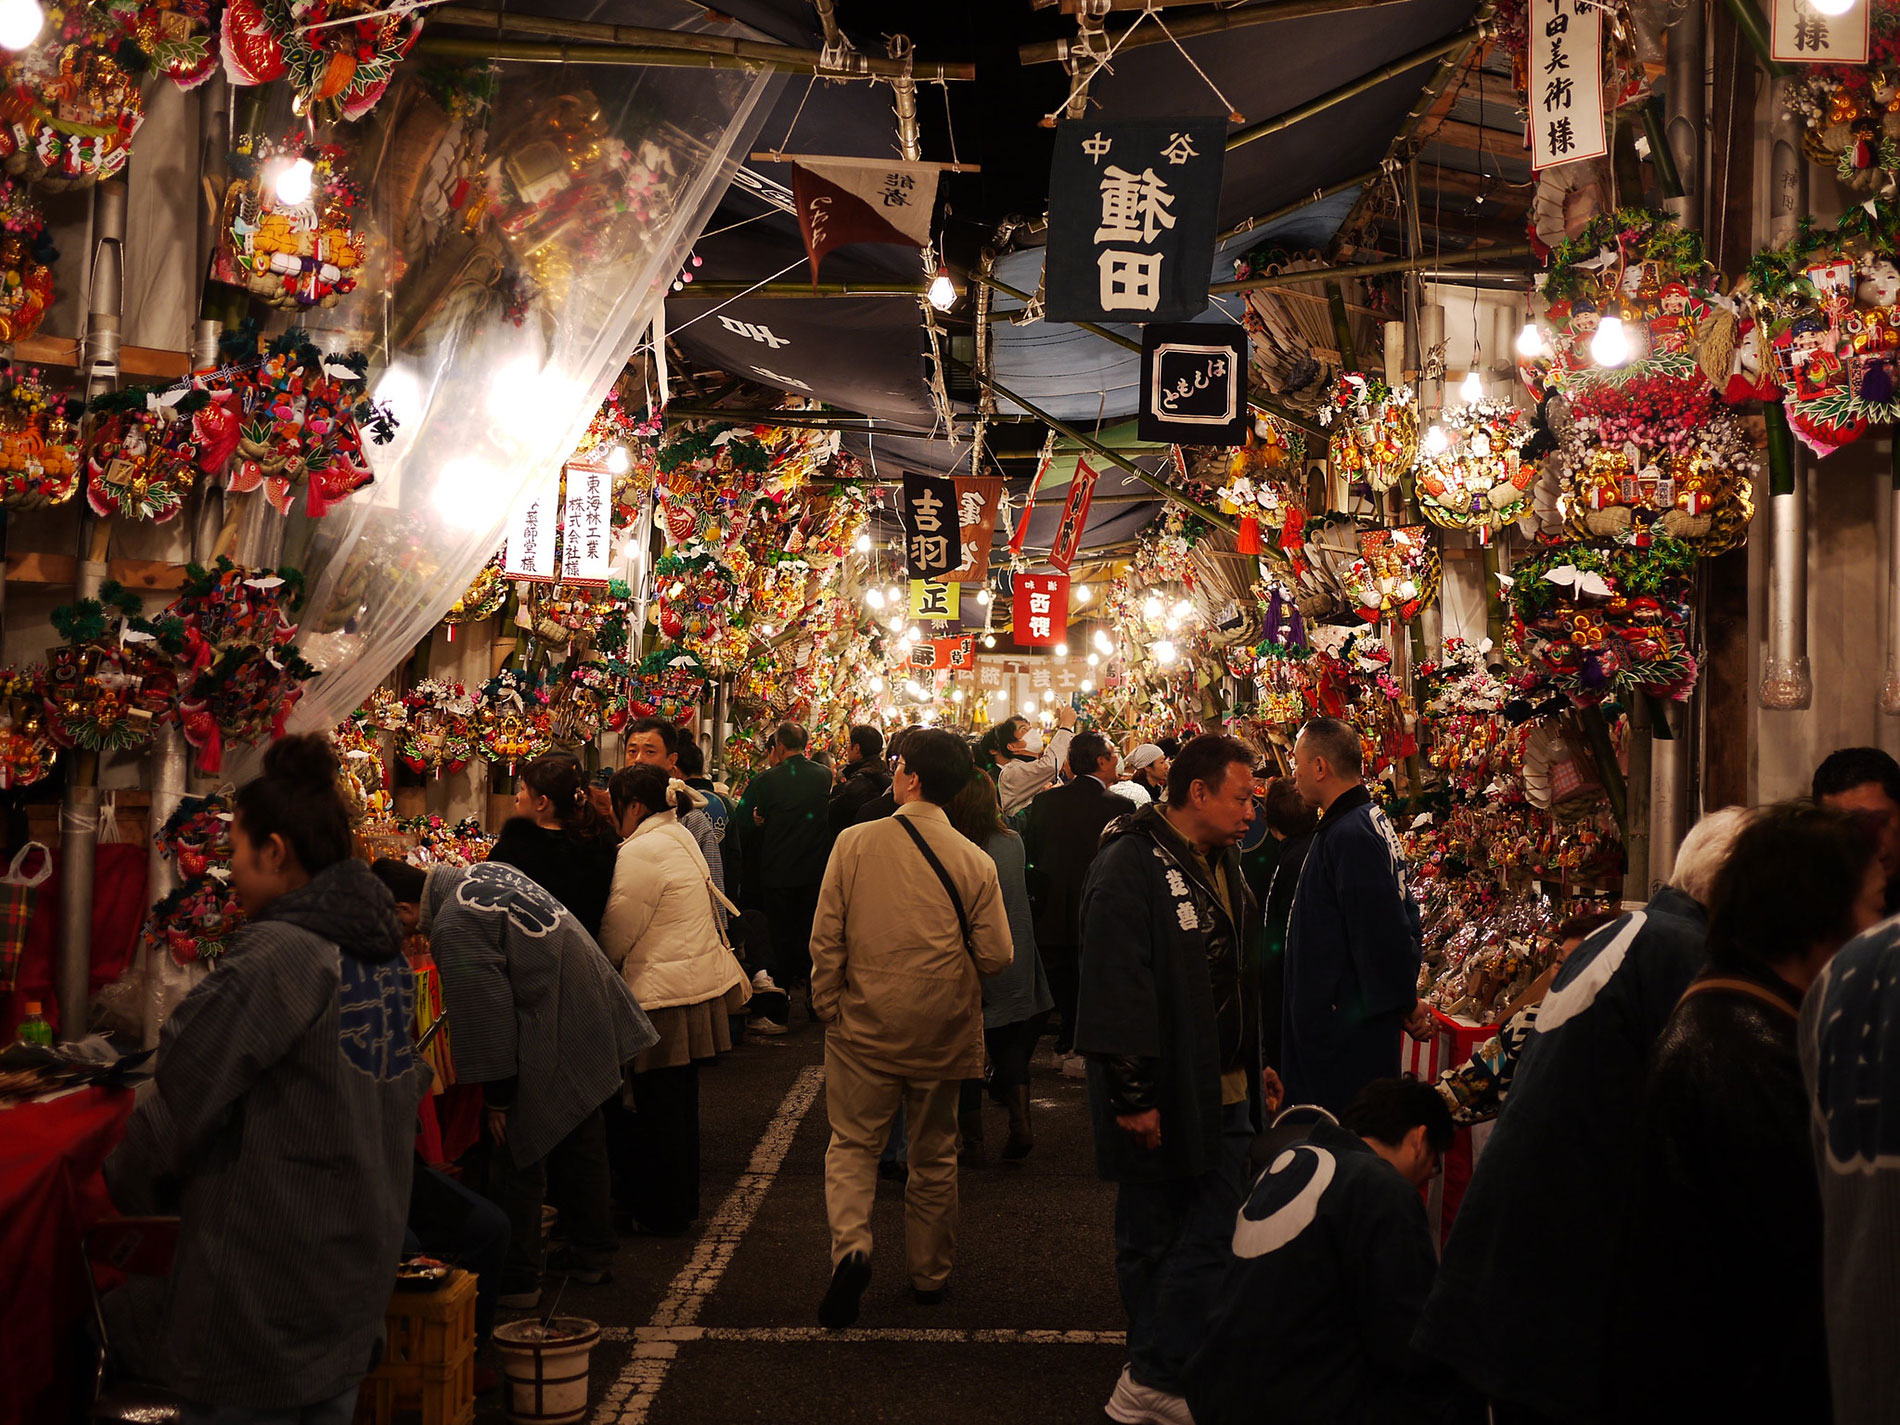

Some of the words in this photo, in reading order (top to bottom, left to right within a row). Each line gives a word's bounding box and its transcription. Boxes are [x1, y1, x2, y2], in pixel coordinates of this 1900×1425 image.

[564, 497, 585, 576] 株式会社様
[586, 474, 602, 559] 東海林工業
[911, 488, 949, 571] 吉羽
[918, 578, 949, 615] 正
